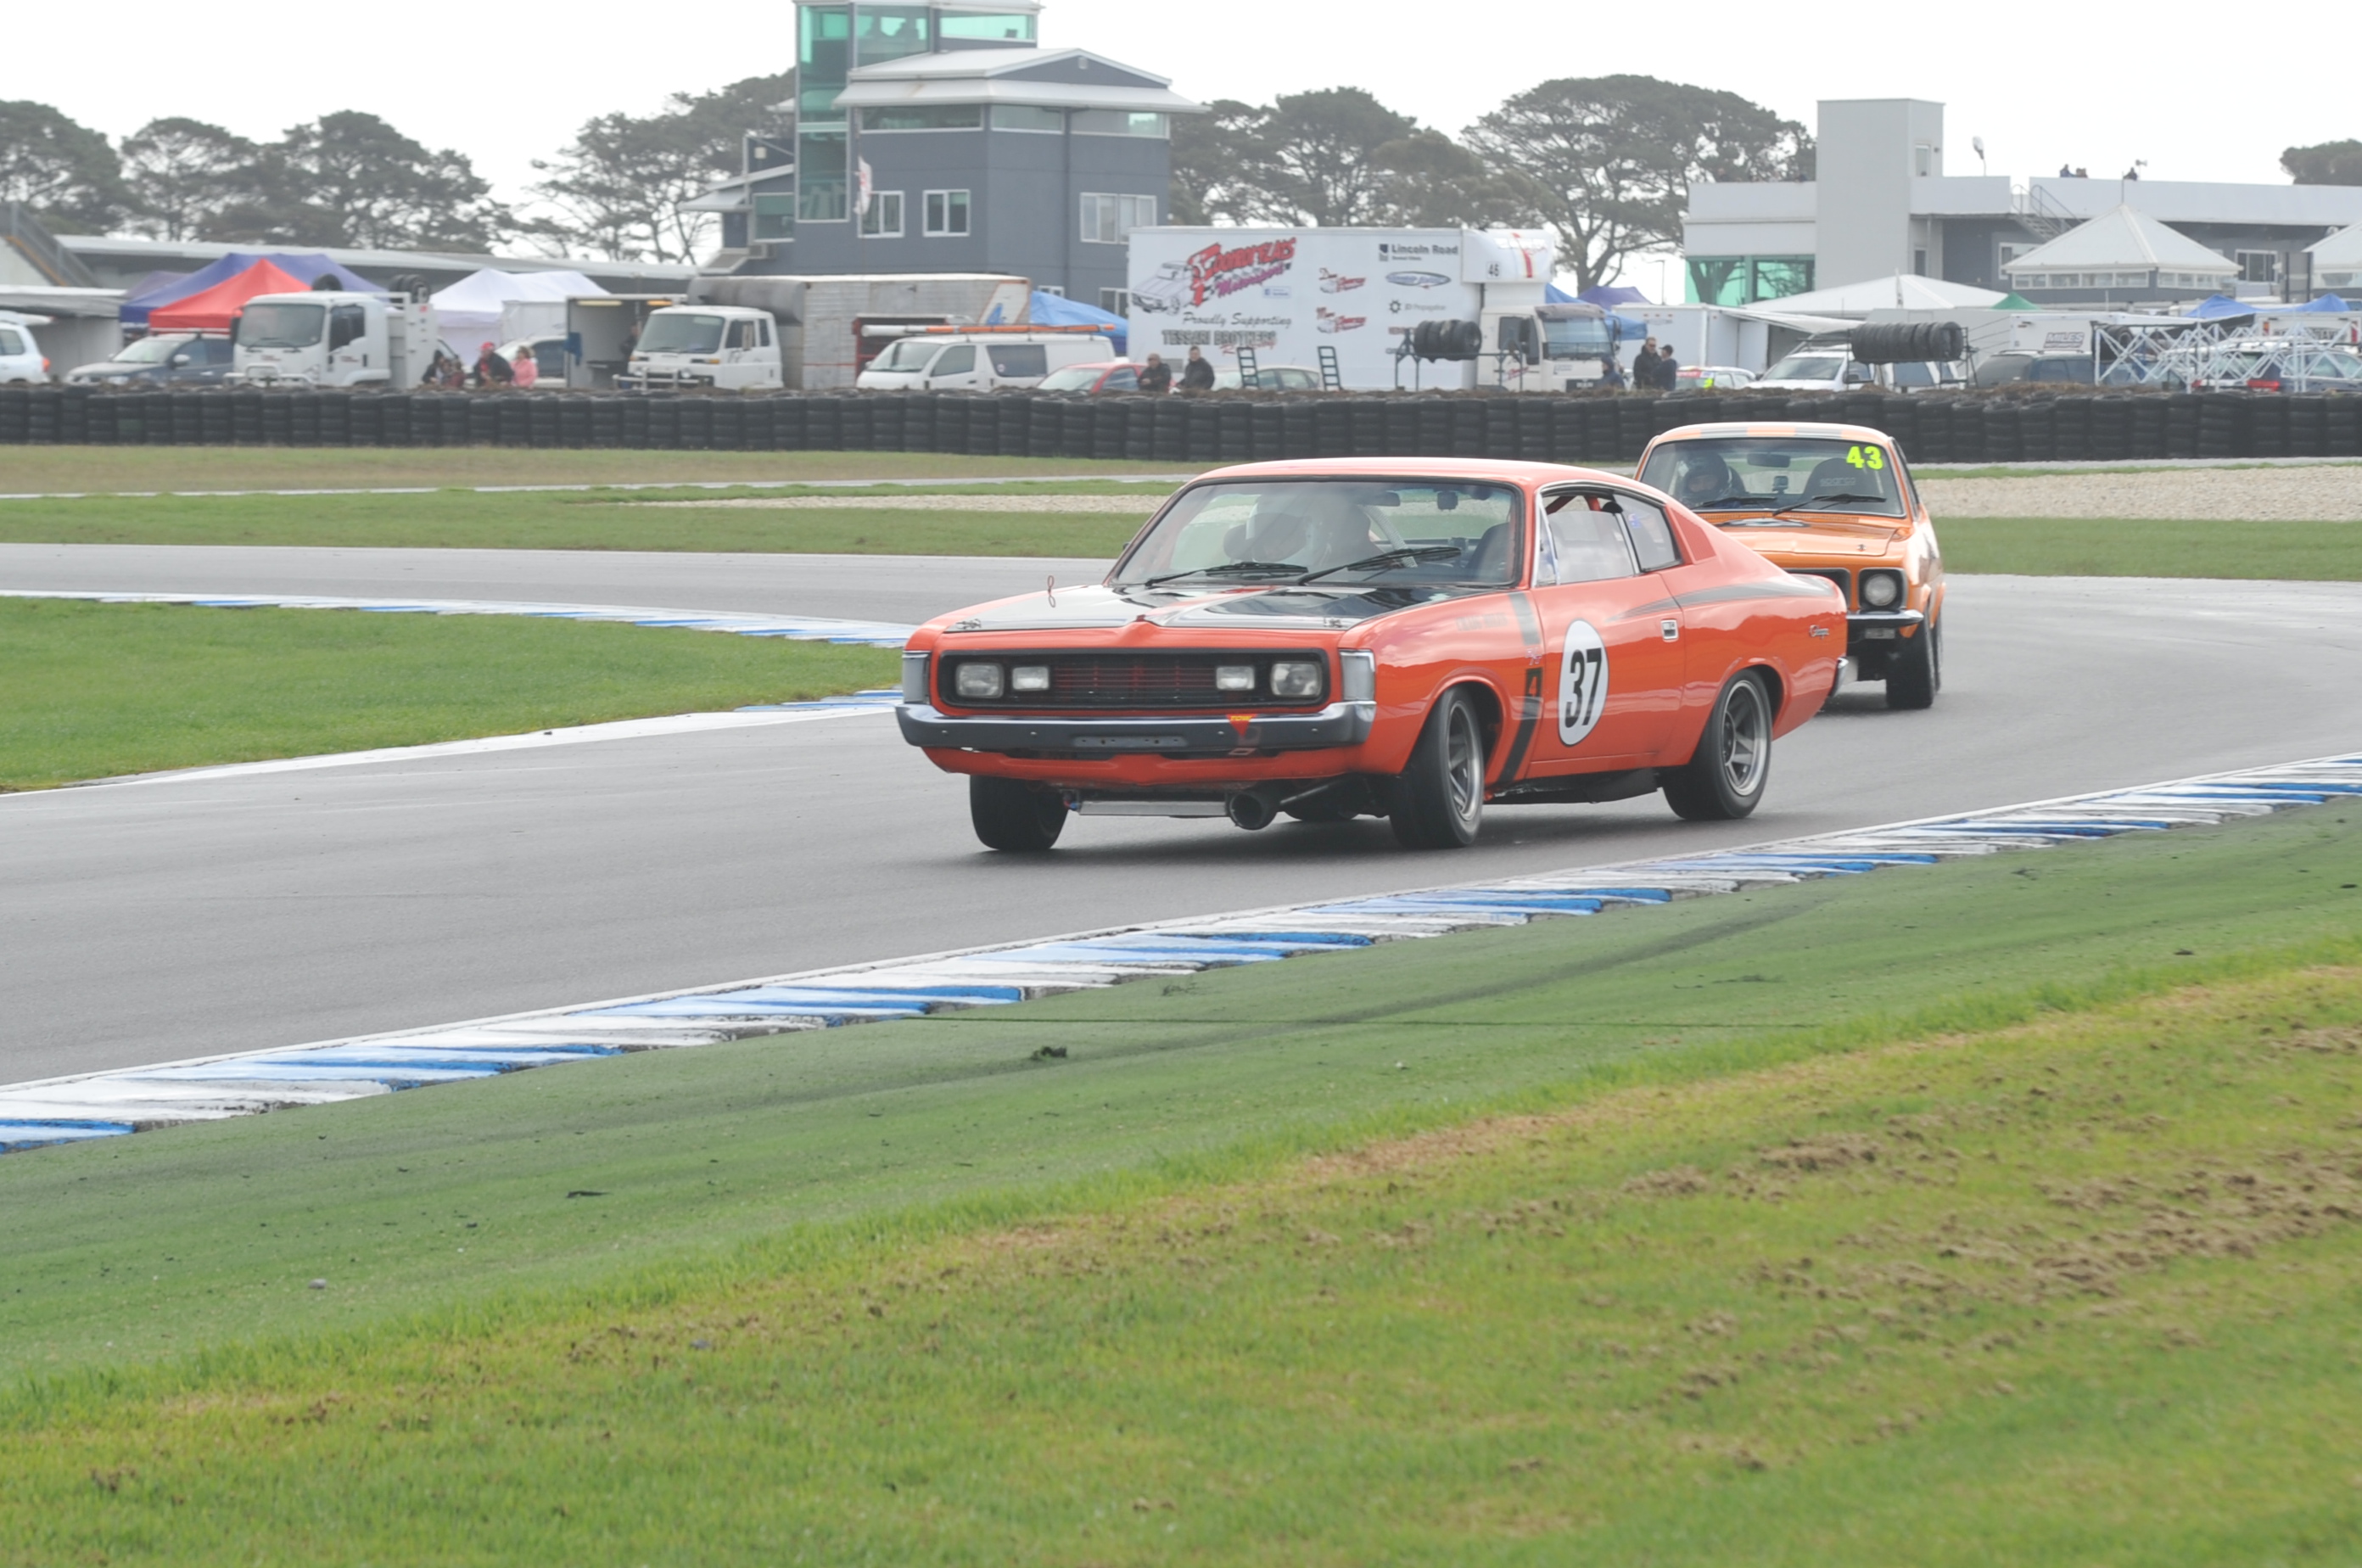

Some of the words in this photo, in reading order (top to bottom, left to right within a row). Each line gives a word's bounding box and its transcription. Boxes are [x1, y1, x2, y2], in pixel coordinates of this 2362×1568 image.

[1391, 244, 1430, 255] Lincoln
[1432, 245, 1458, 255] Road
[1183, 311, 1226, 328] Proudly
[1231, 312, 1292, 328] Supporting
[1213, 330, 1276, 346] BROTHERS
[2046, 333, 2085, 342] MILES
[1846, 446, 1883, 469] 43
[1564, 647, 1602, 728] 37
